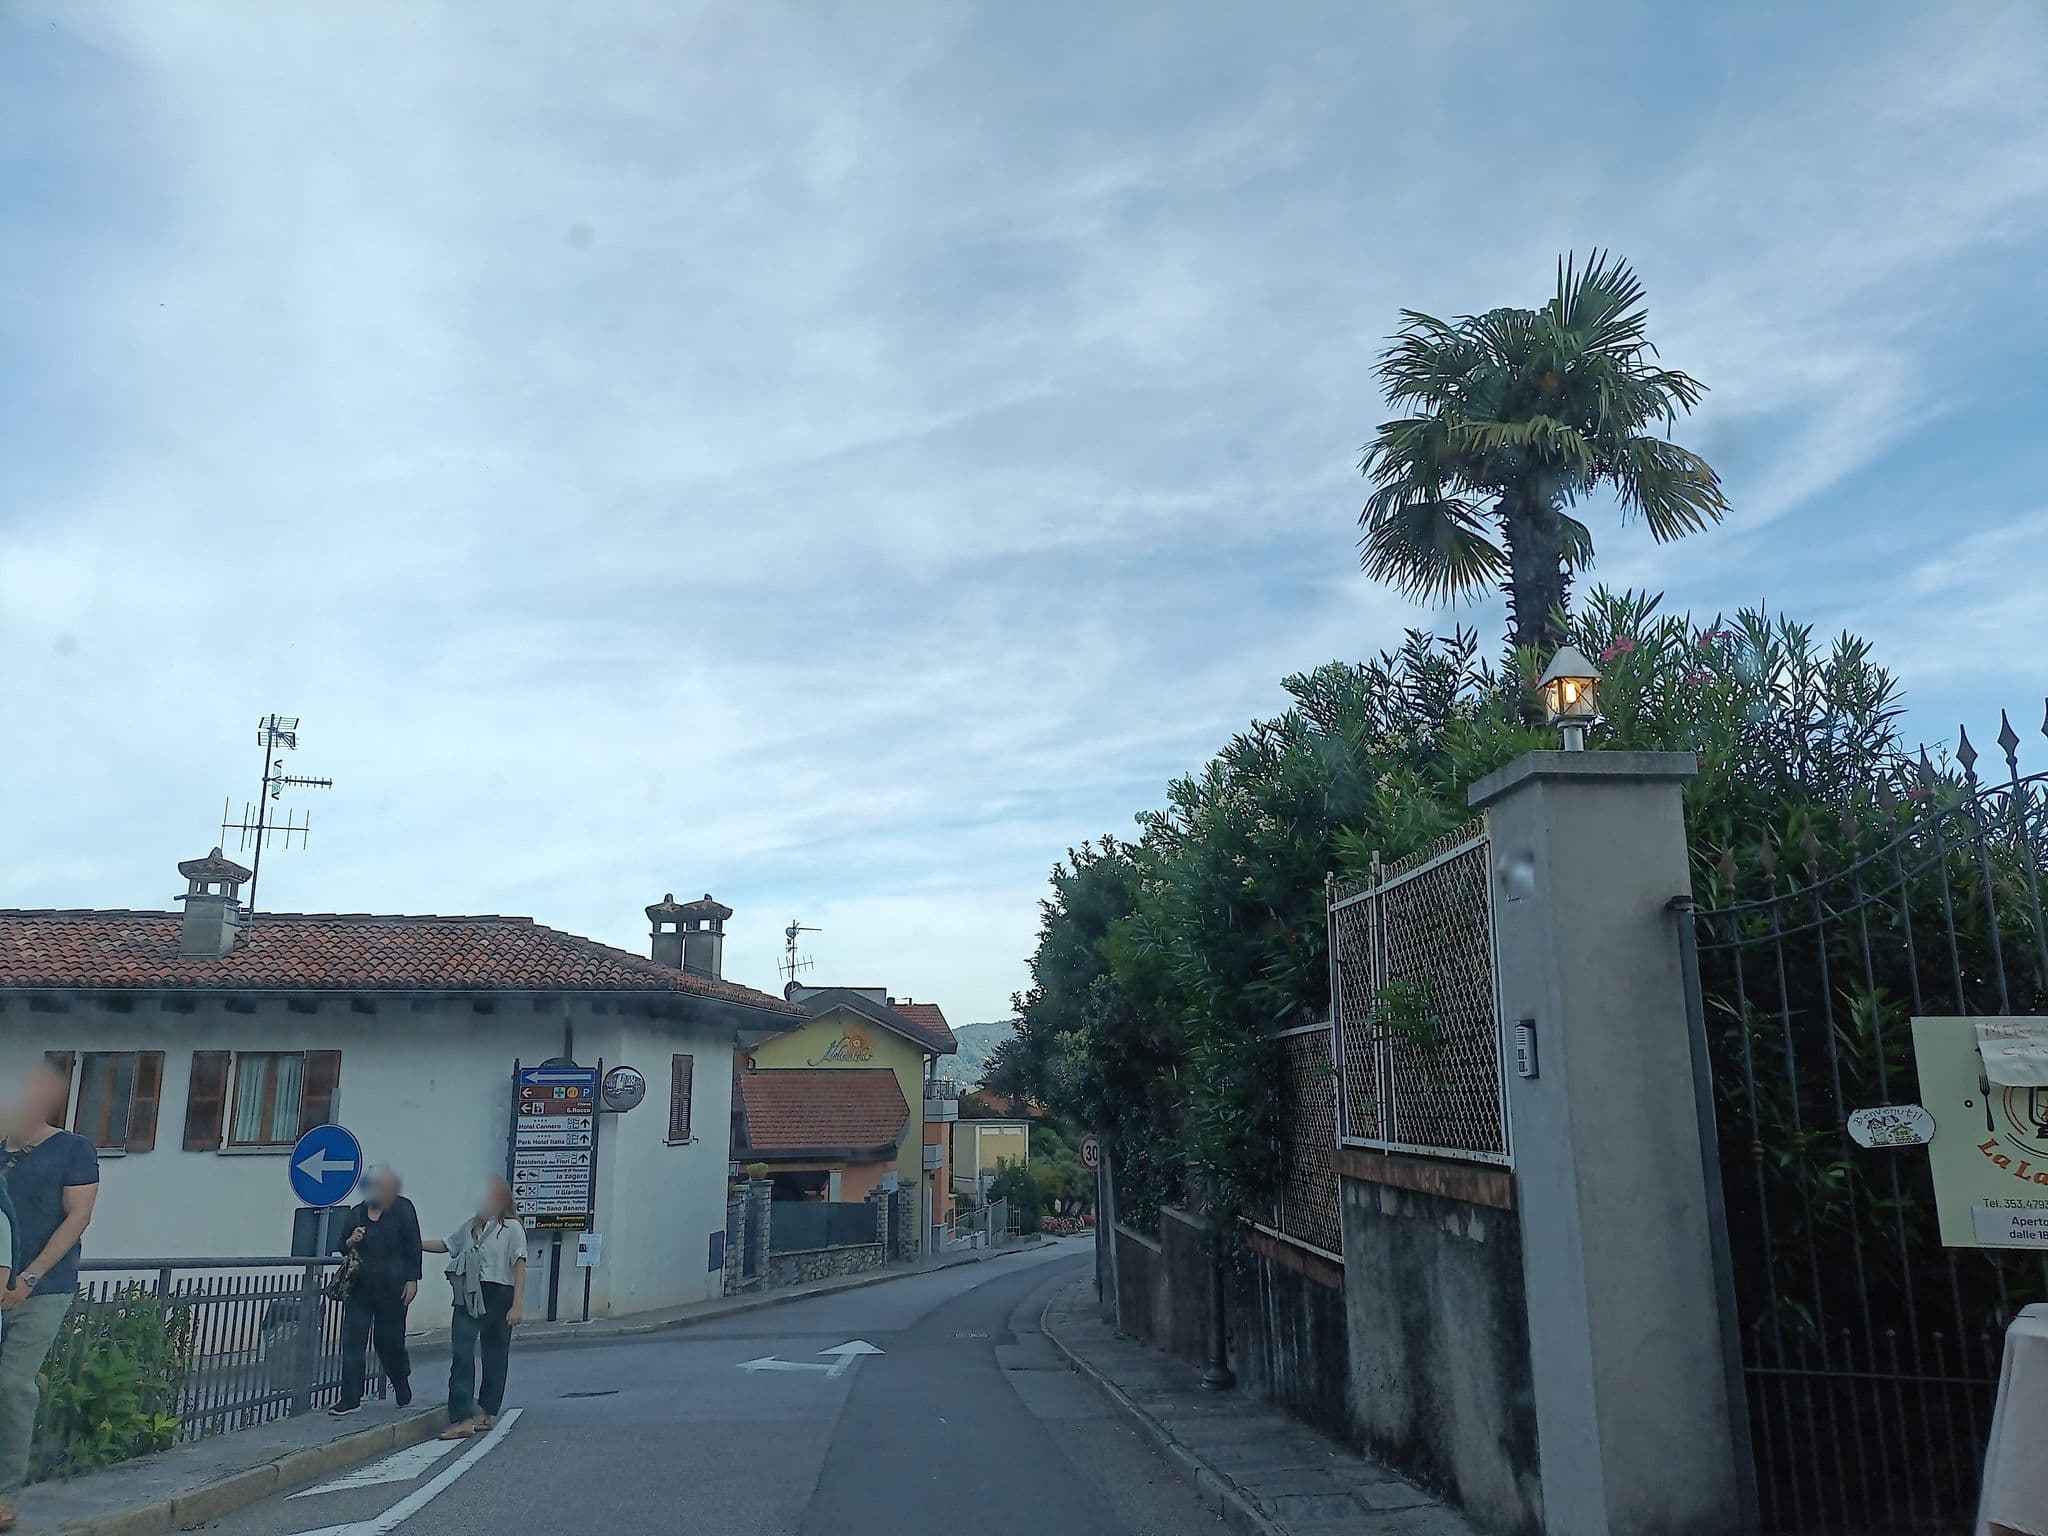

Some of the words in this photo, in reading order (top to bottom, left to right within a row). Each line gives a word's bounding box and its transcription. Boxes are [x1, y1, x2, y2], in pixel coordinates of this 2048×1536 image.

[583, 1088, 590, 1097] P
[1086, 1145, 1098, 1161] 30
[1977, 1138, 2011, 1169] La
[1983, 1199, 2002, 1208] Tel.
[2011, 1216, 2048, 1227] Aperto
[2009, 1230, 2036, 1239] dalle
